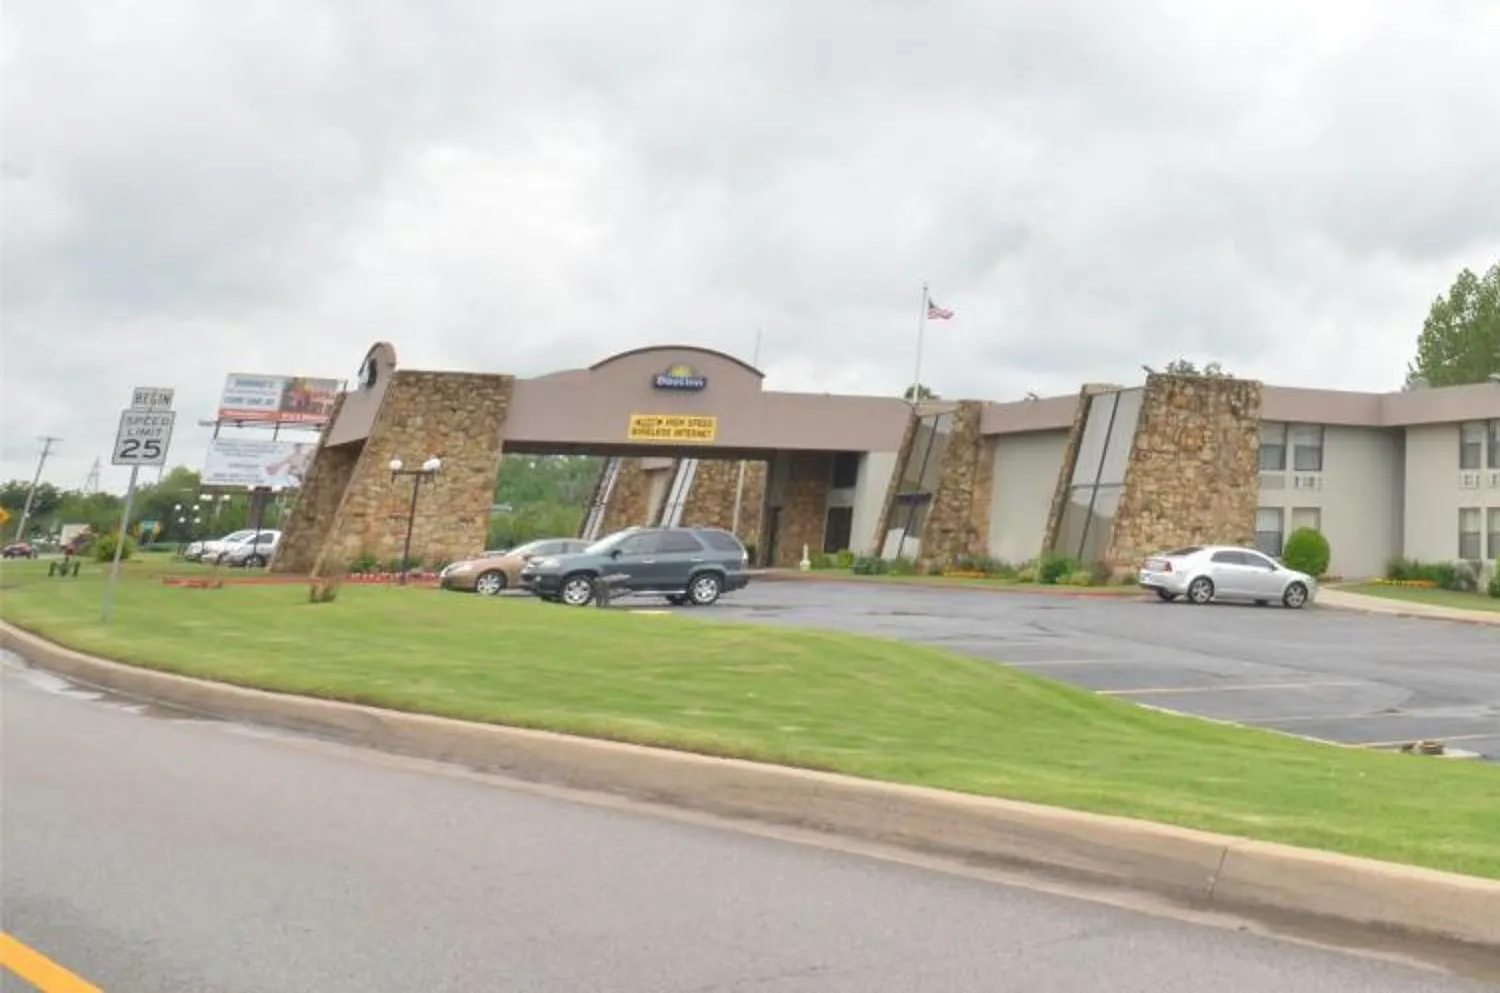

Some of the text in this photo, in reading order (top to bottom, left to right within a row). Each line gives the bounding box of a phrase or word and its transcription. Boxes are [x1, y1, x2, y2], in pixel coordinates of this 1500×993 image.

[134, 392, 171, 406] BEGIN
[126, 415, 169, 425] SPEED
[127, 428, 162, 436] LIMIT
[119, 439, 161, 458] 25
